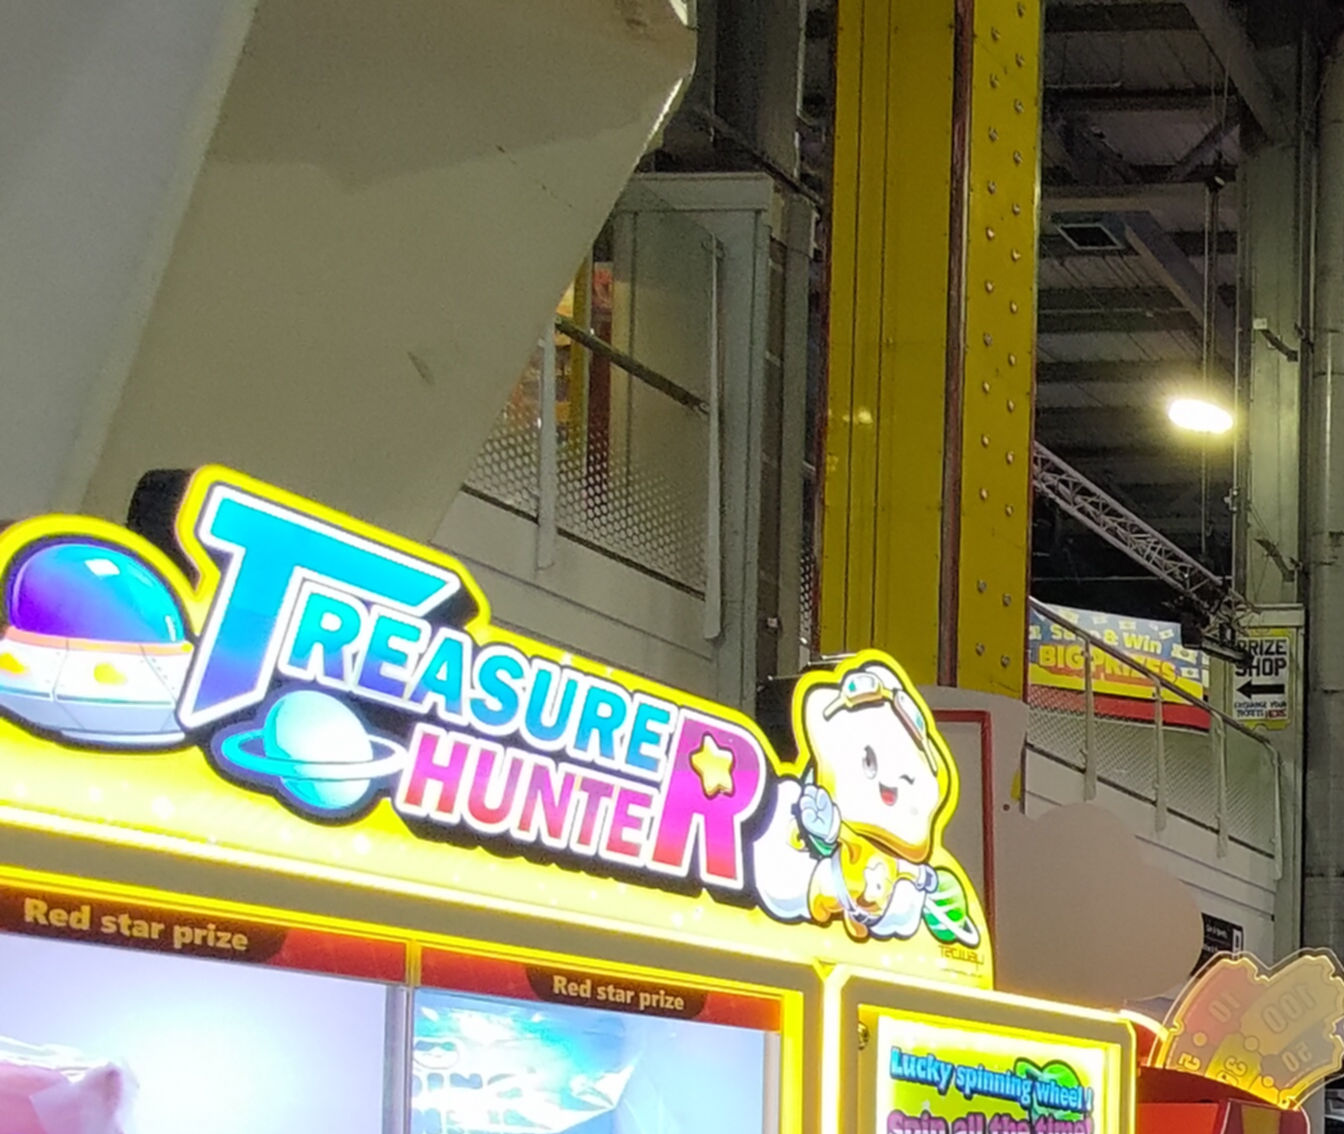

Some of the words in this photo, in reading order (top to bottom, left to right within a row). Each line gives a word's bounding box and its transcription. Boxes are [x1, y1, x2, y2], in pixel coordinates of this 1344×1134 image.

[179, 486, 675, 777] TREASURE
[1039, 644, 1084, 670] BIG
[1122, 631, 1162, 653] Win
[395, 716, 768, 889] HUNTER
[24, 897, 91, 931] Red
[101, 914, 165, 940] star
[172, 921, 250, 952] prize
[552, 975, 592, 999] Red
[597, 982, 635, 1004] star
[639, 987, 686, 1011] prize
[890, 1046, 953, 1095] Lucky
[955, 1063, 1033, 1110] spinning
